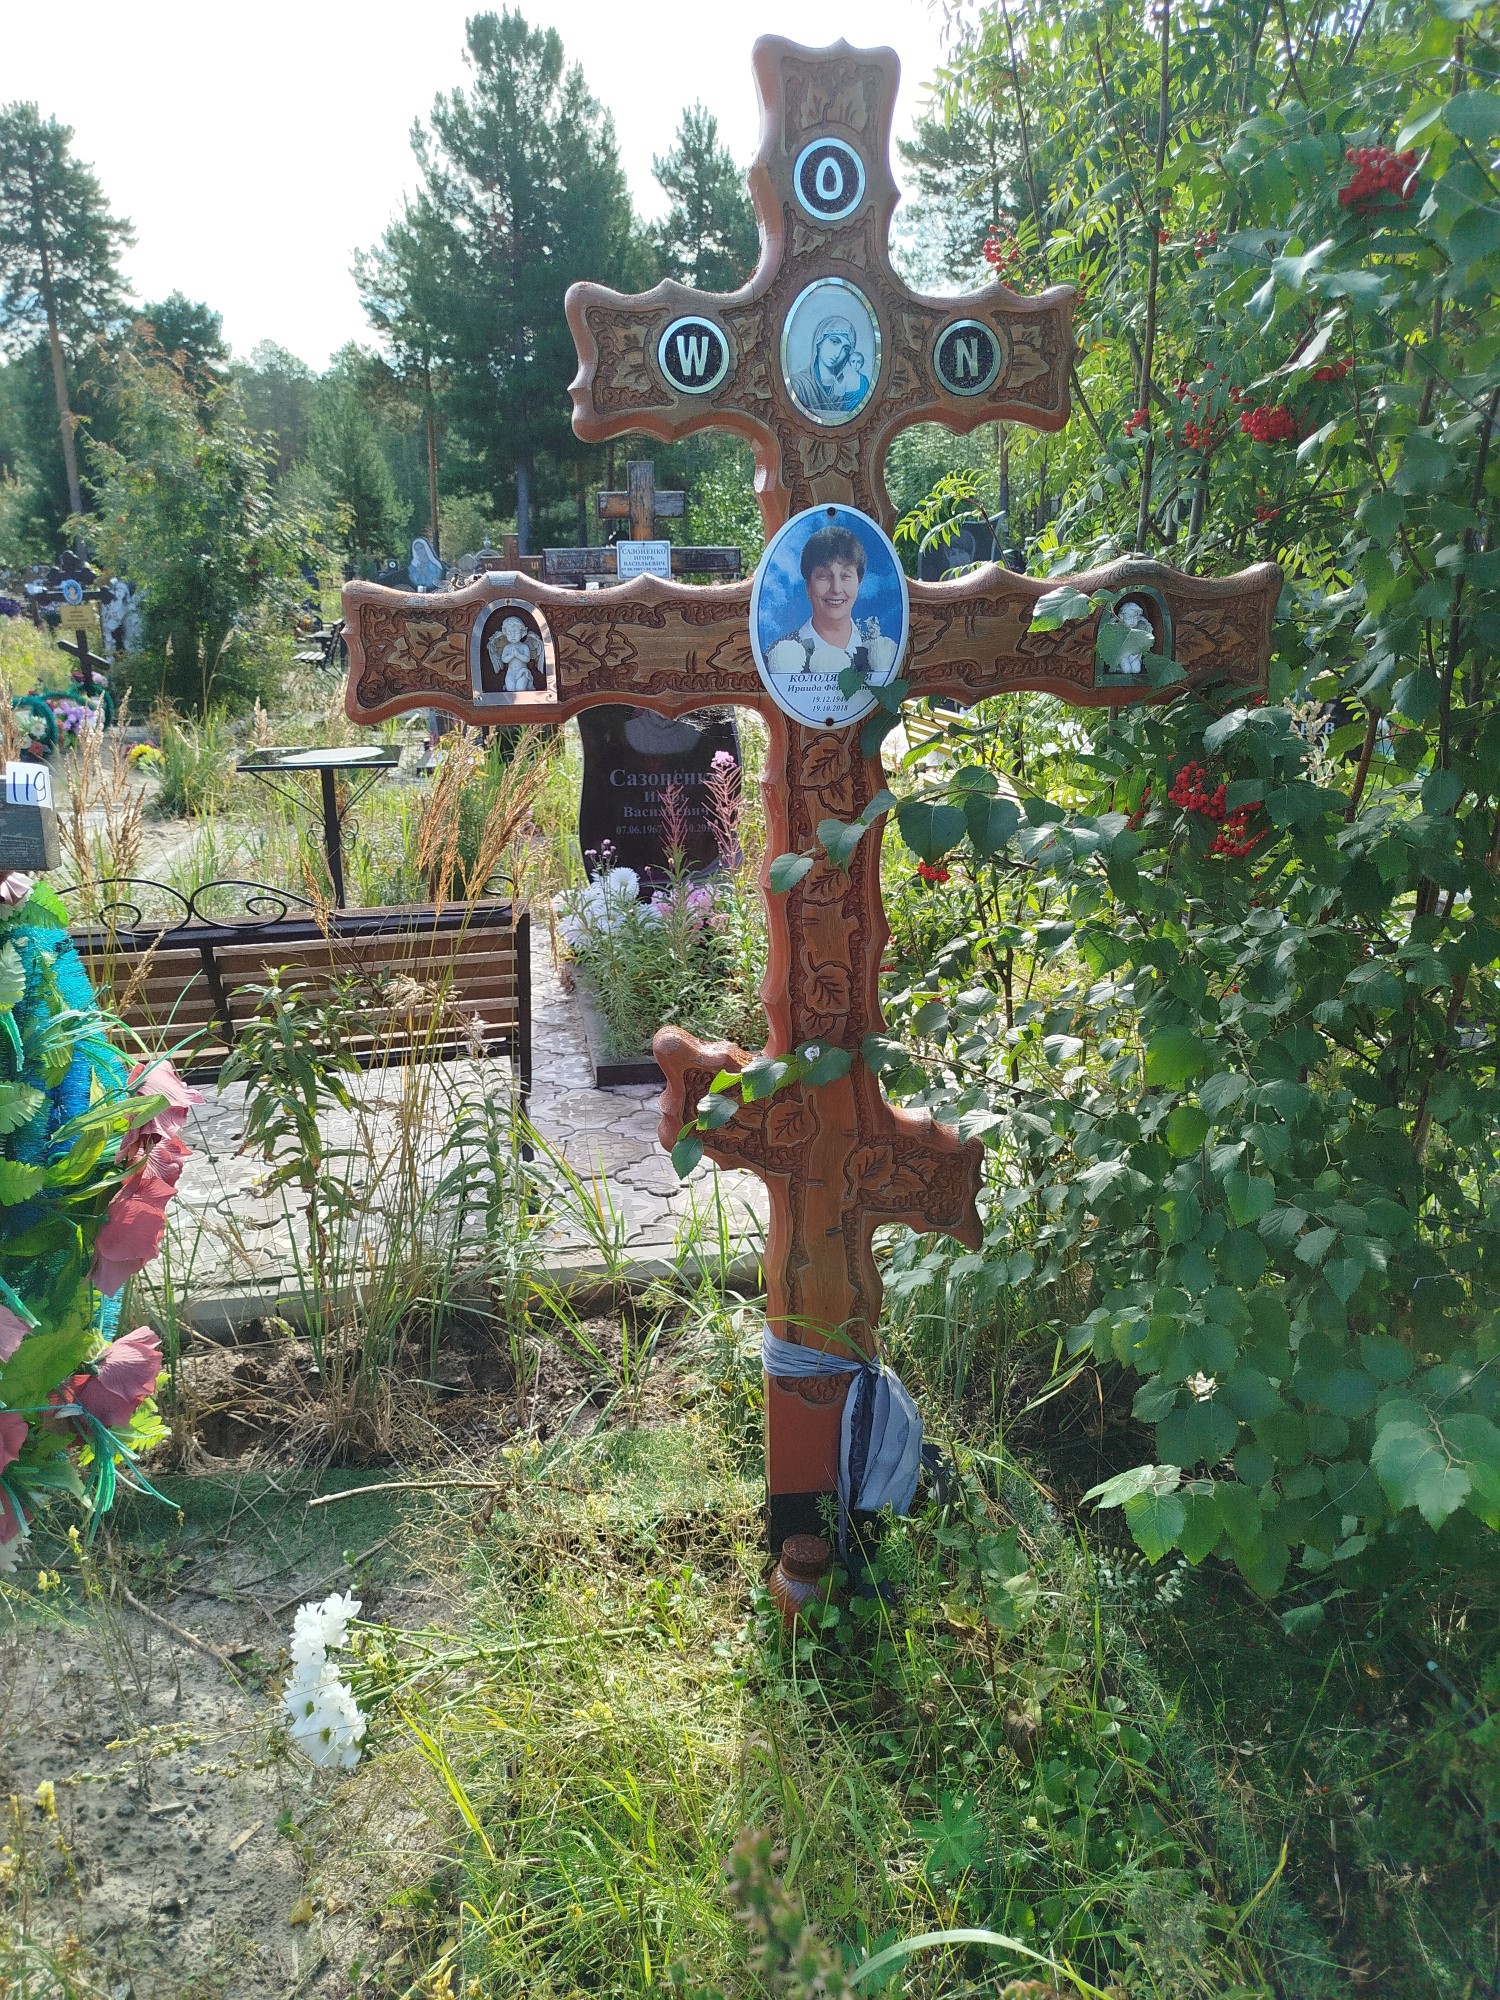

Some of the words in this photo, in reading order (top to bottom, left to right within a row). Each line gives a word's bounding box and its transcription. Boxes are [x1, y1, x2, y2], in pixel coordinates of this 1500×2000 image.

[621, 548, 667, 556] САЗОНЕНКО
[789, 673, 873, 684] КОЛОДЯЯ
[787, 684, 822, 694] Ираида
[812, 704, 849, 713] 19.10.2018
[12, 770, 47, 803] 119
